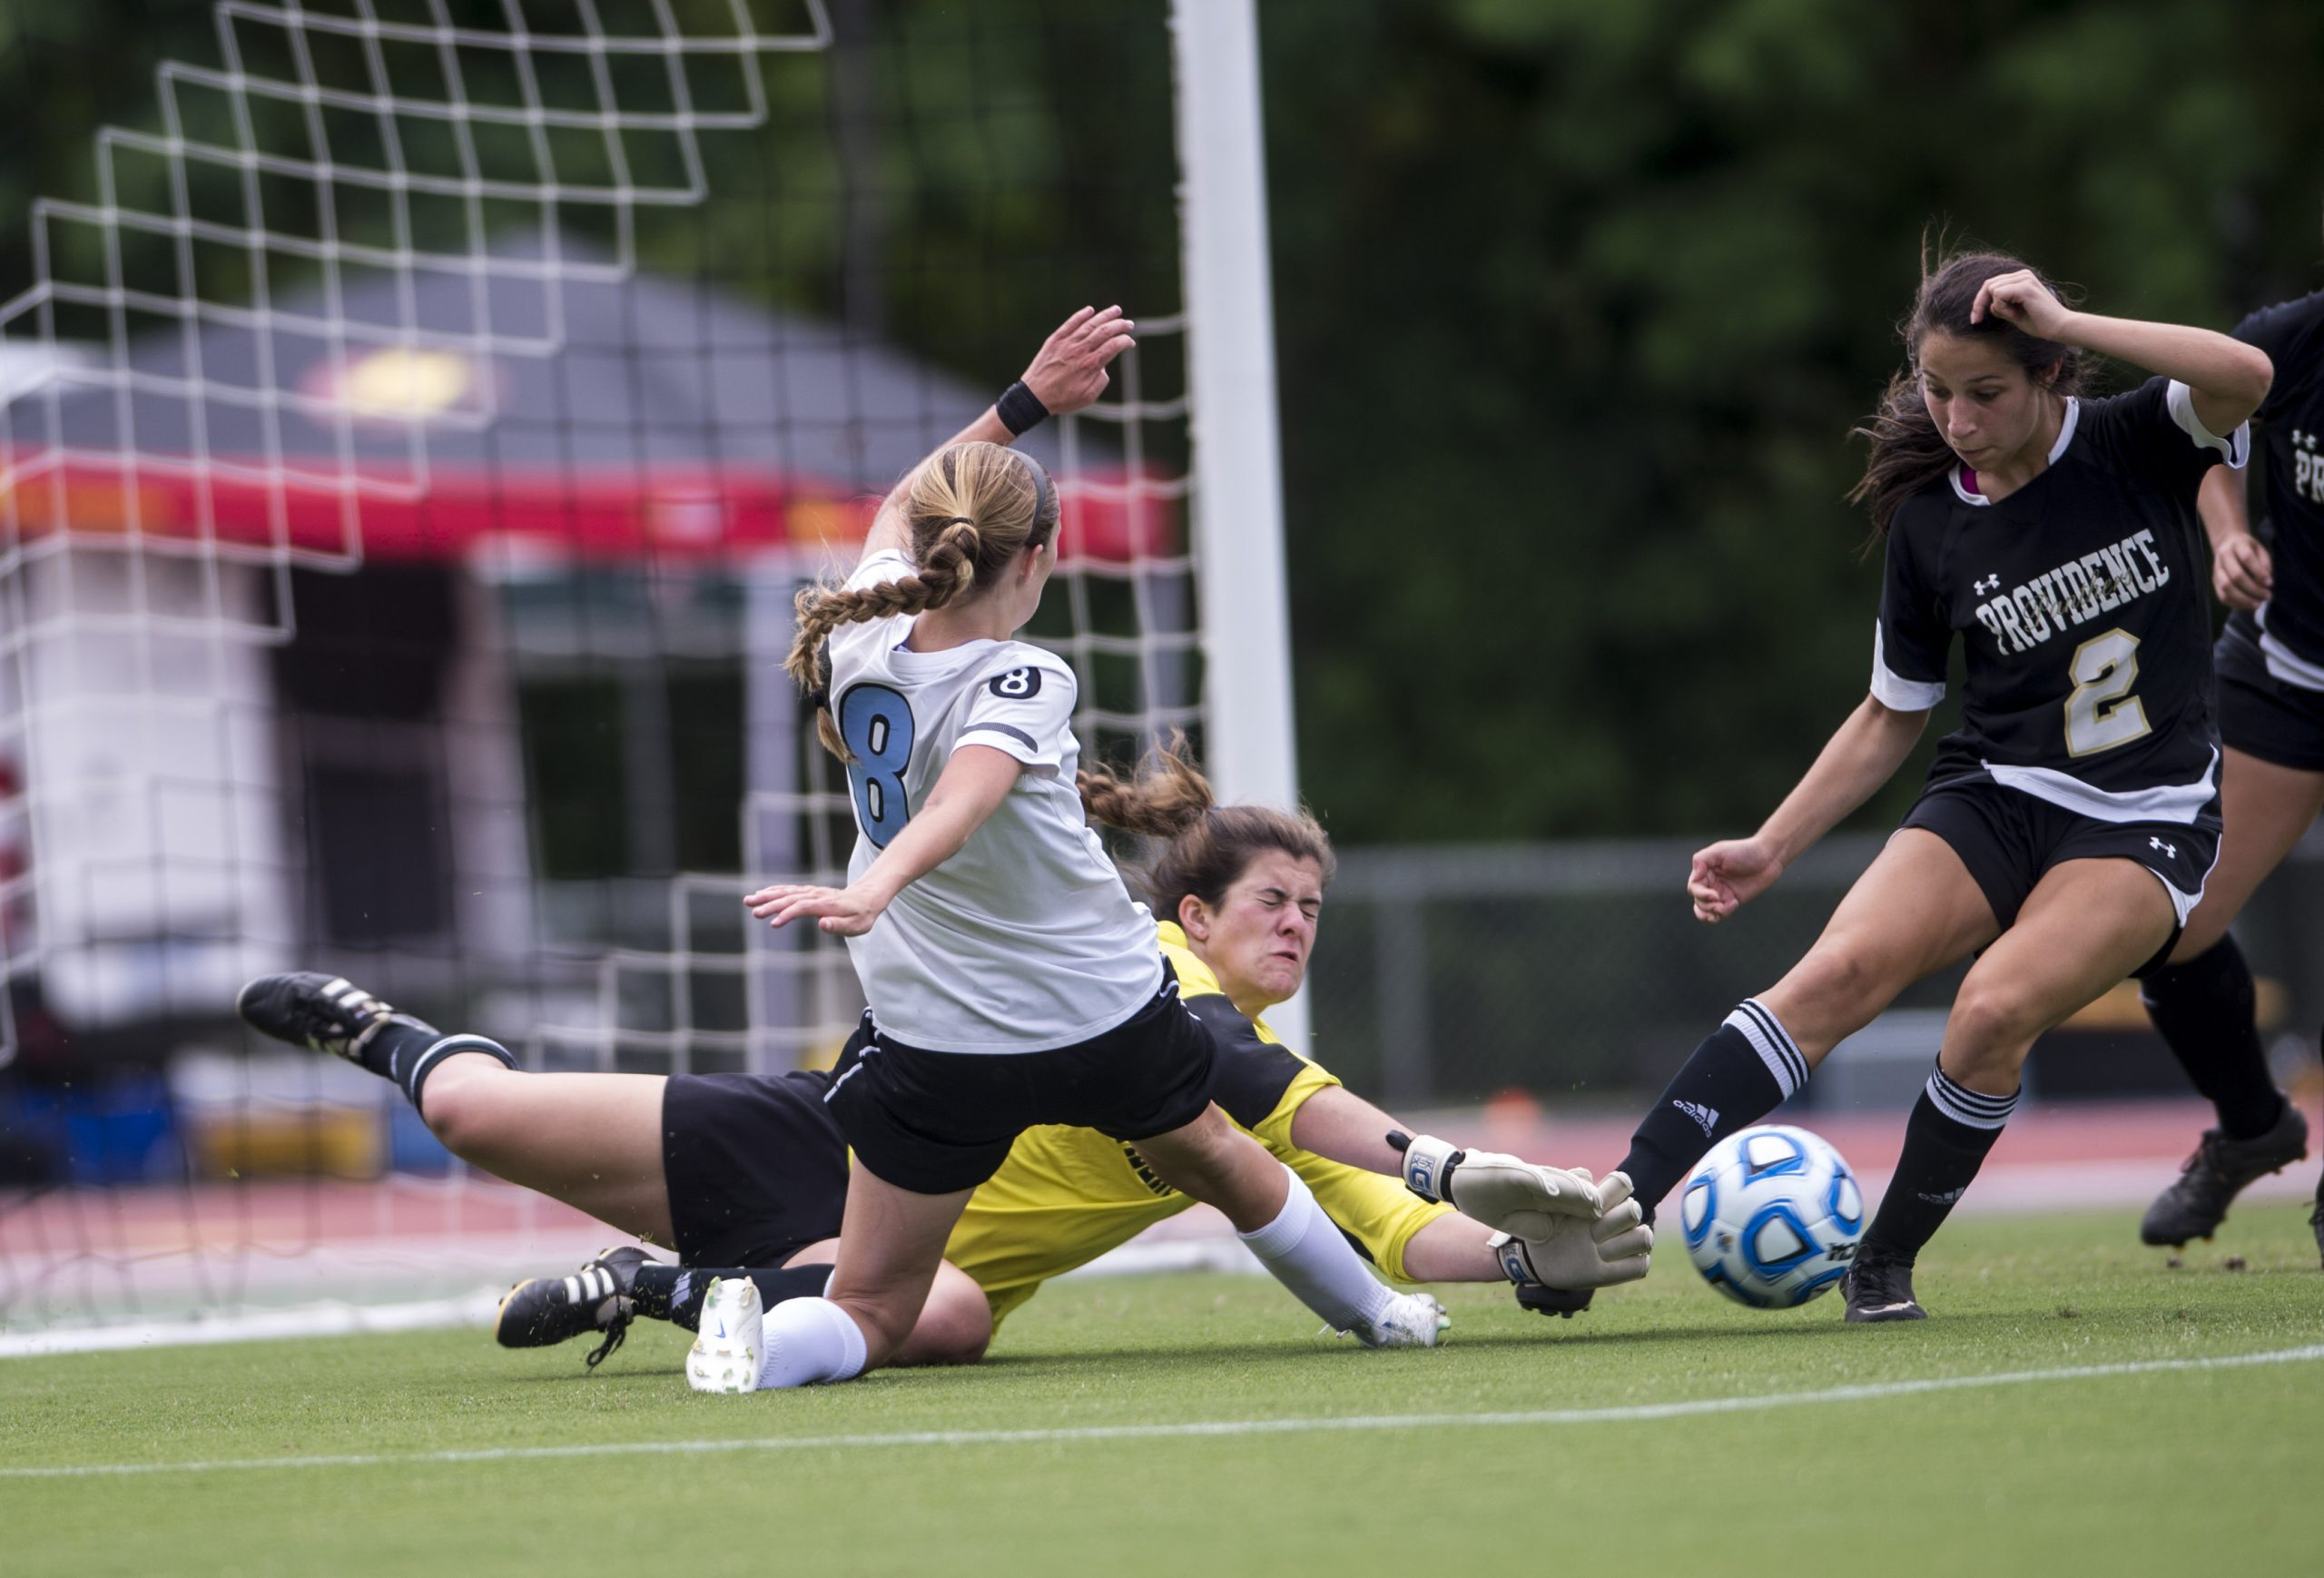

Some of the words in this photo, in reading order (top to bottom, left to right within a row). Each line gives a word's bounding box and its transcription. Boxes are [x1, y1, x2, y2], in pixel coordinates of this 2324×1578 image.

[1975, 528, 2170, 656] PROVIDENCE
[997, 666, 1033, 695] 8
[2063, 626, 2152, 758] 2
[839, 682, 915, 850] 8
[1672, 1099, 1713, 1139] adidas
